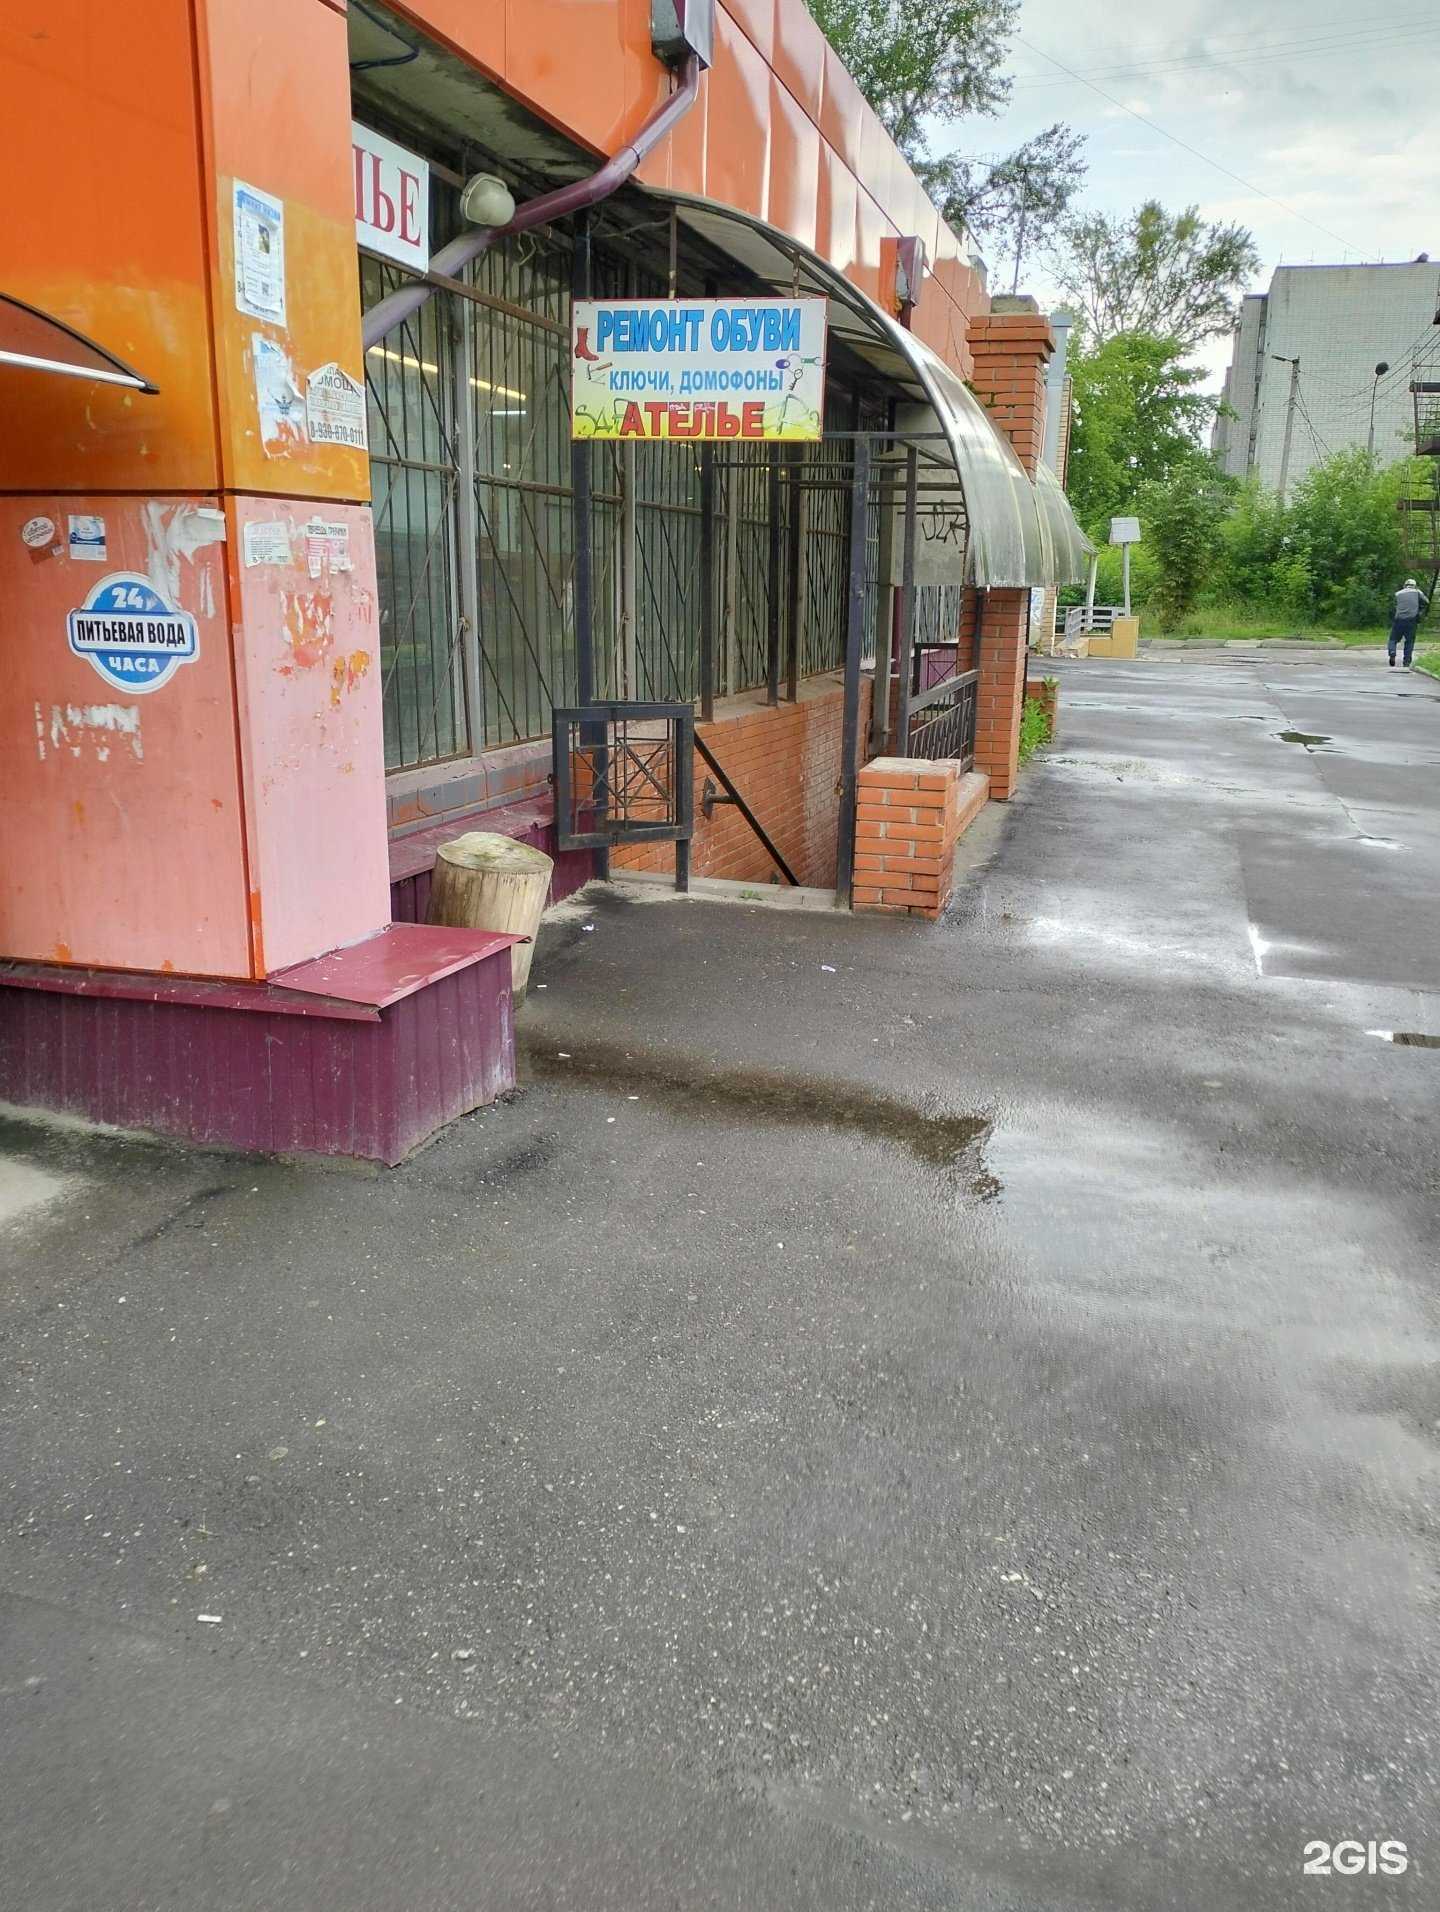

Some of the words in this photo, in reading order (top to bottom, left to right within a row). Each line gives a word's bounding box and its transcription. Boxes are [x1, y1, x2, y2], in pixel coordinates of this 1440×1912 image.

[597, 309, 704, 352] РЕМОНТ
[711, 308, 801, 352] ОБУВИ
[609, 370, 675, 395] КЛЮЧИ,
[679, 370, 783, 394] ДОМОФОНЫ
[619, 401, 766, 437] АТЕЛЬЕ
[112, 587, 144, 608] 24
[77, 620, 144, 643] ПИТЬЕВАЯ
[147, 622, 186, 647] ВОДА
[108, 656, 161, 672] ЧАСА
